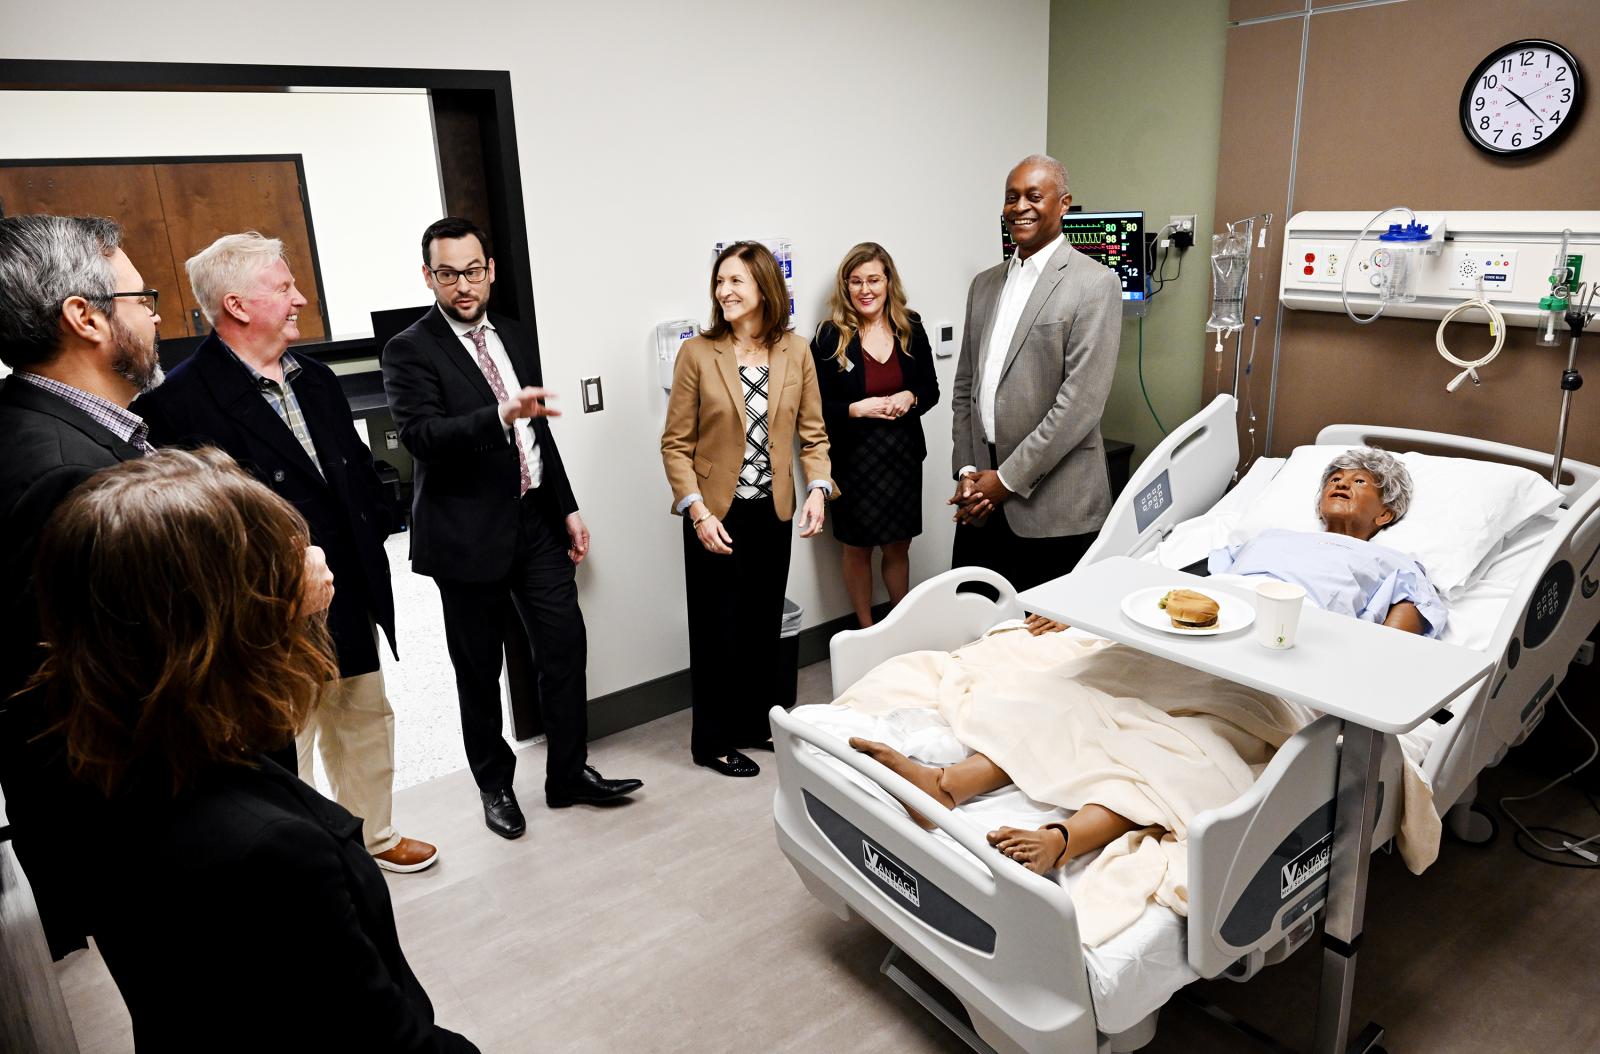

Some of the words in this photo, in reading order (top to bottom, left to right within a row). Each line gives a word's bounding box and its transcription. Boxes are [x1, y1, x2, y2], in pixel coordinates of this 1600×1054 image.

[1520, 51, 1534, 66] 12
[1545, 54, 1551, 68] 1
[1501, 59, 1512, 73] 11
[1555, 67, 1566, 81] 2
[1482, 75, 1497, 89] 10
[1560, 88, 1571, 103] 3
[1475, 97, 1485, 111] 9
[1480, 116, 1490, 130] 8
[1550, 110, 1561, 124] 4
[1494, 130, 1503, 143] 7
[1512, 132, 1522, 146] 6
[1532, 126, 1543, 140] 5
[1106, 224, 1116, 232] 80
[1126, 223, 1138, 232] 80
[1127, 268, 1138, 276] 12
[864, 843, 916, 895] VANTAGE
